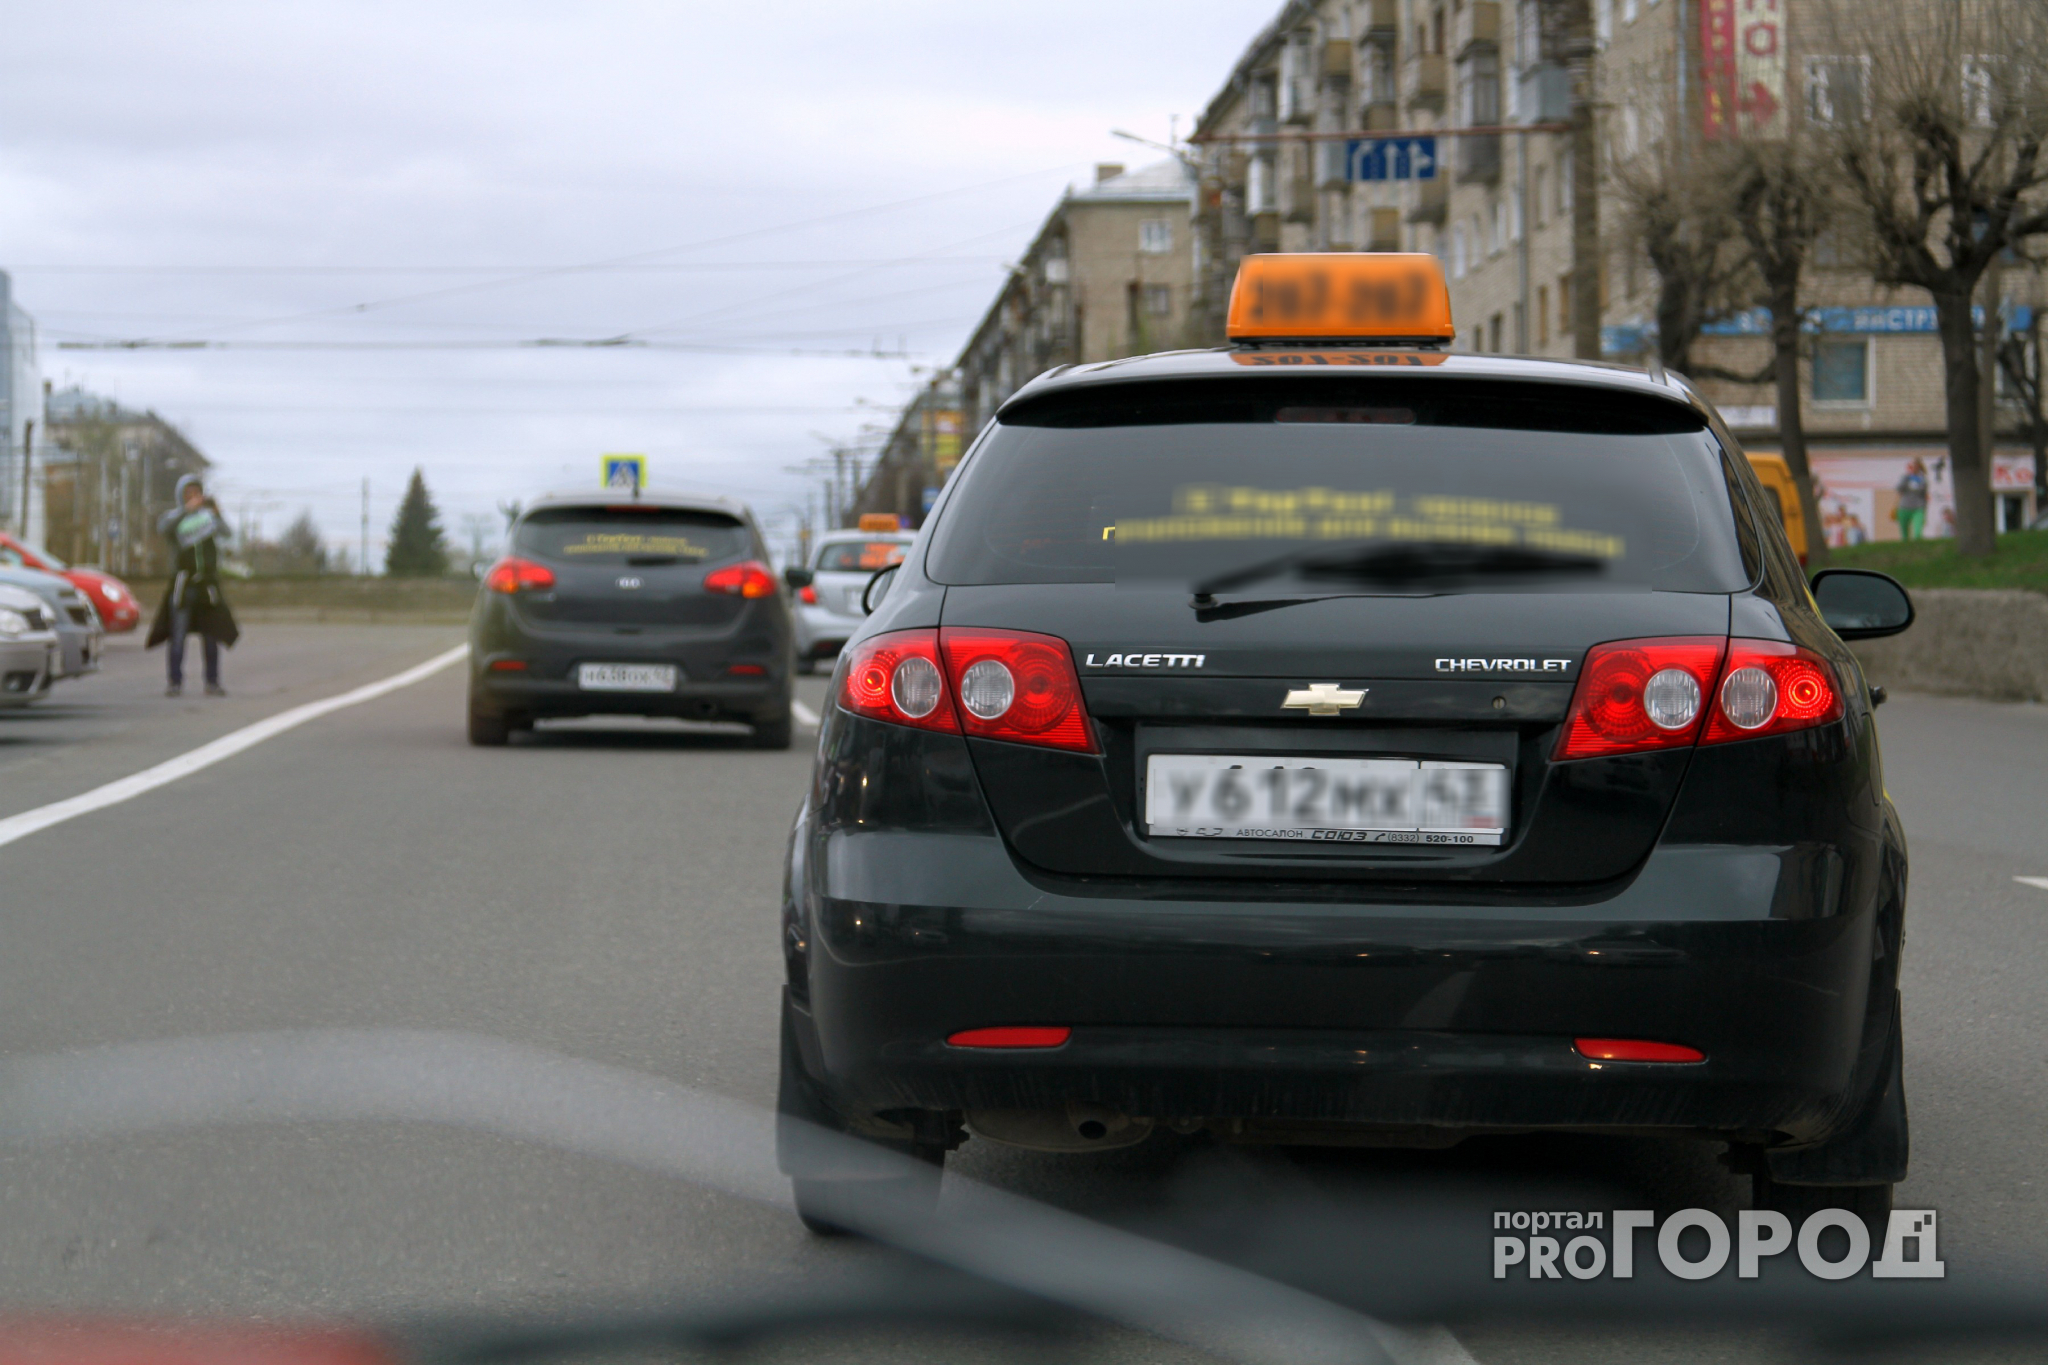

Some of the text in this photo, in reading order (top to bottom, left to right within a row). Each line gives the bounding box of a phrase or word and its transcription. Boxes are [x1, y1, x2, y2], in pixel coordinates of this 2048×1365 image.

[1085, 653, 1206, 668] LACETTI
[1435, 657, 1571, 673] CHEVROLET
[1312, 830, 1367, 841] СОЮЗ
[1387, 833, 1420, 843] (8332)
[1425, 835, 1474, 844] 520-100
